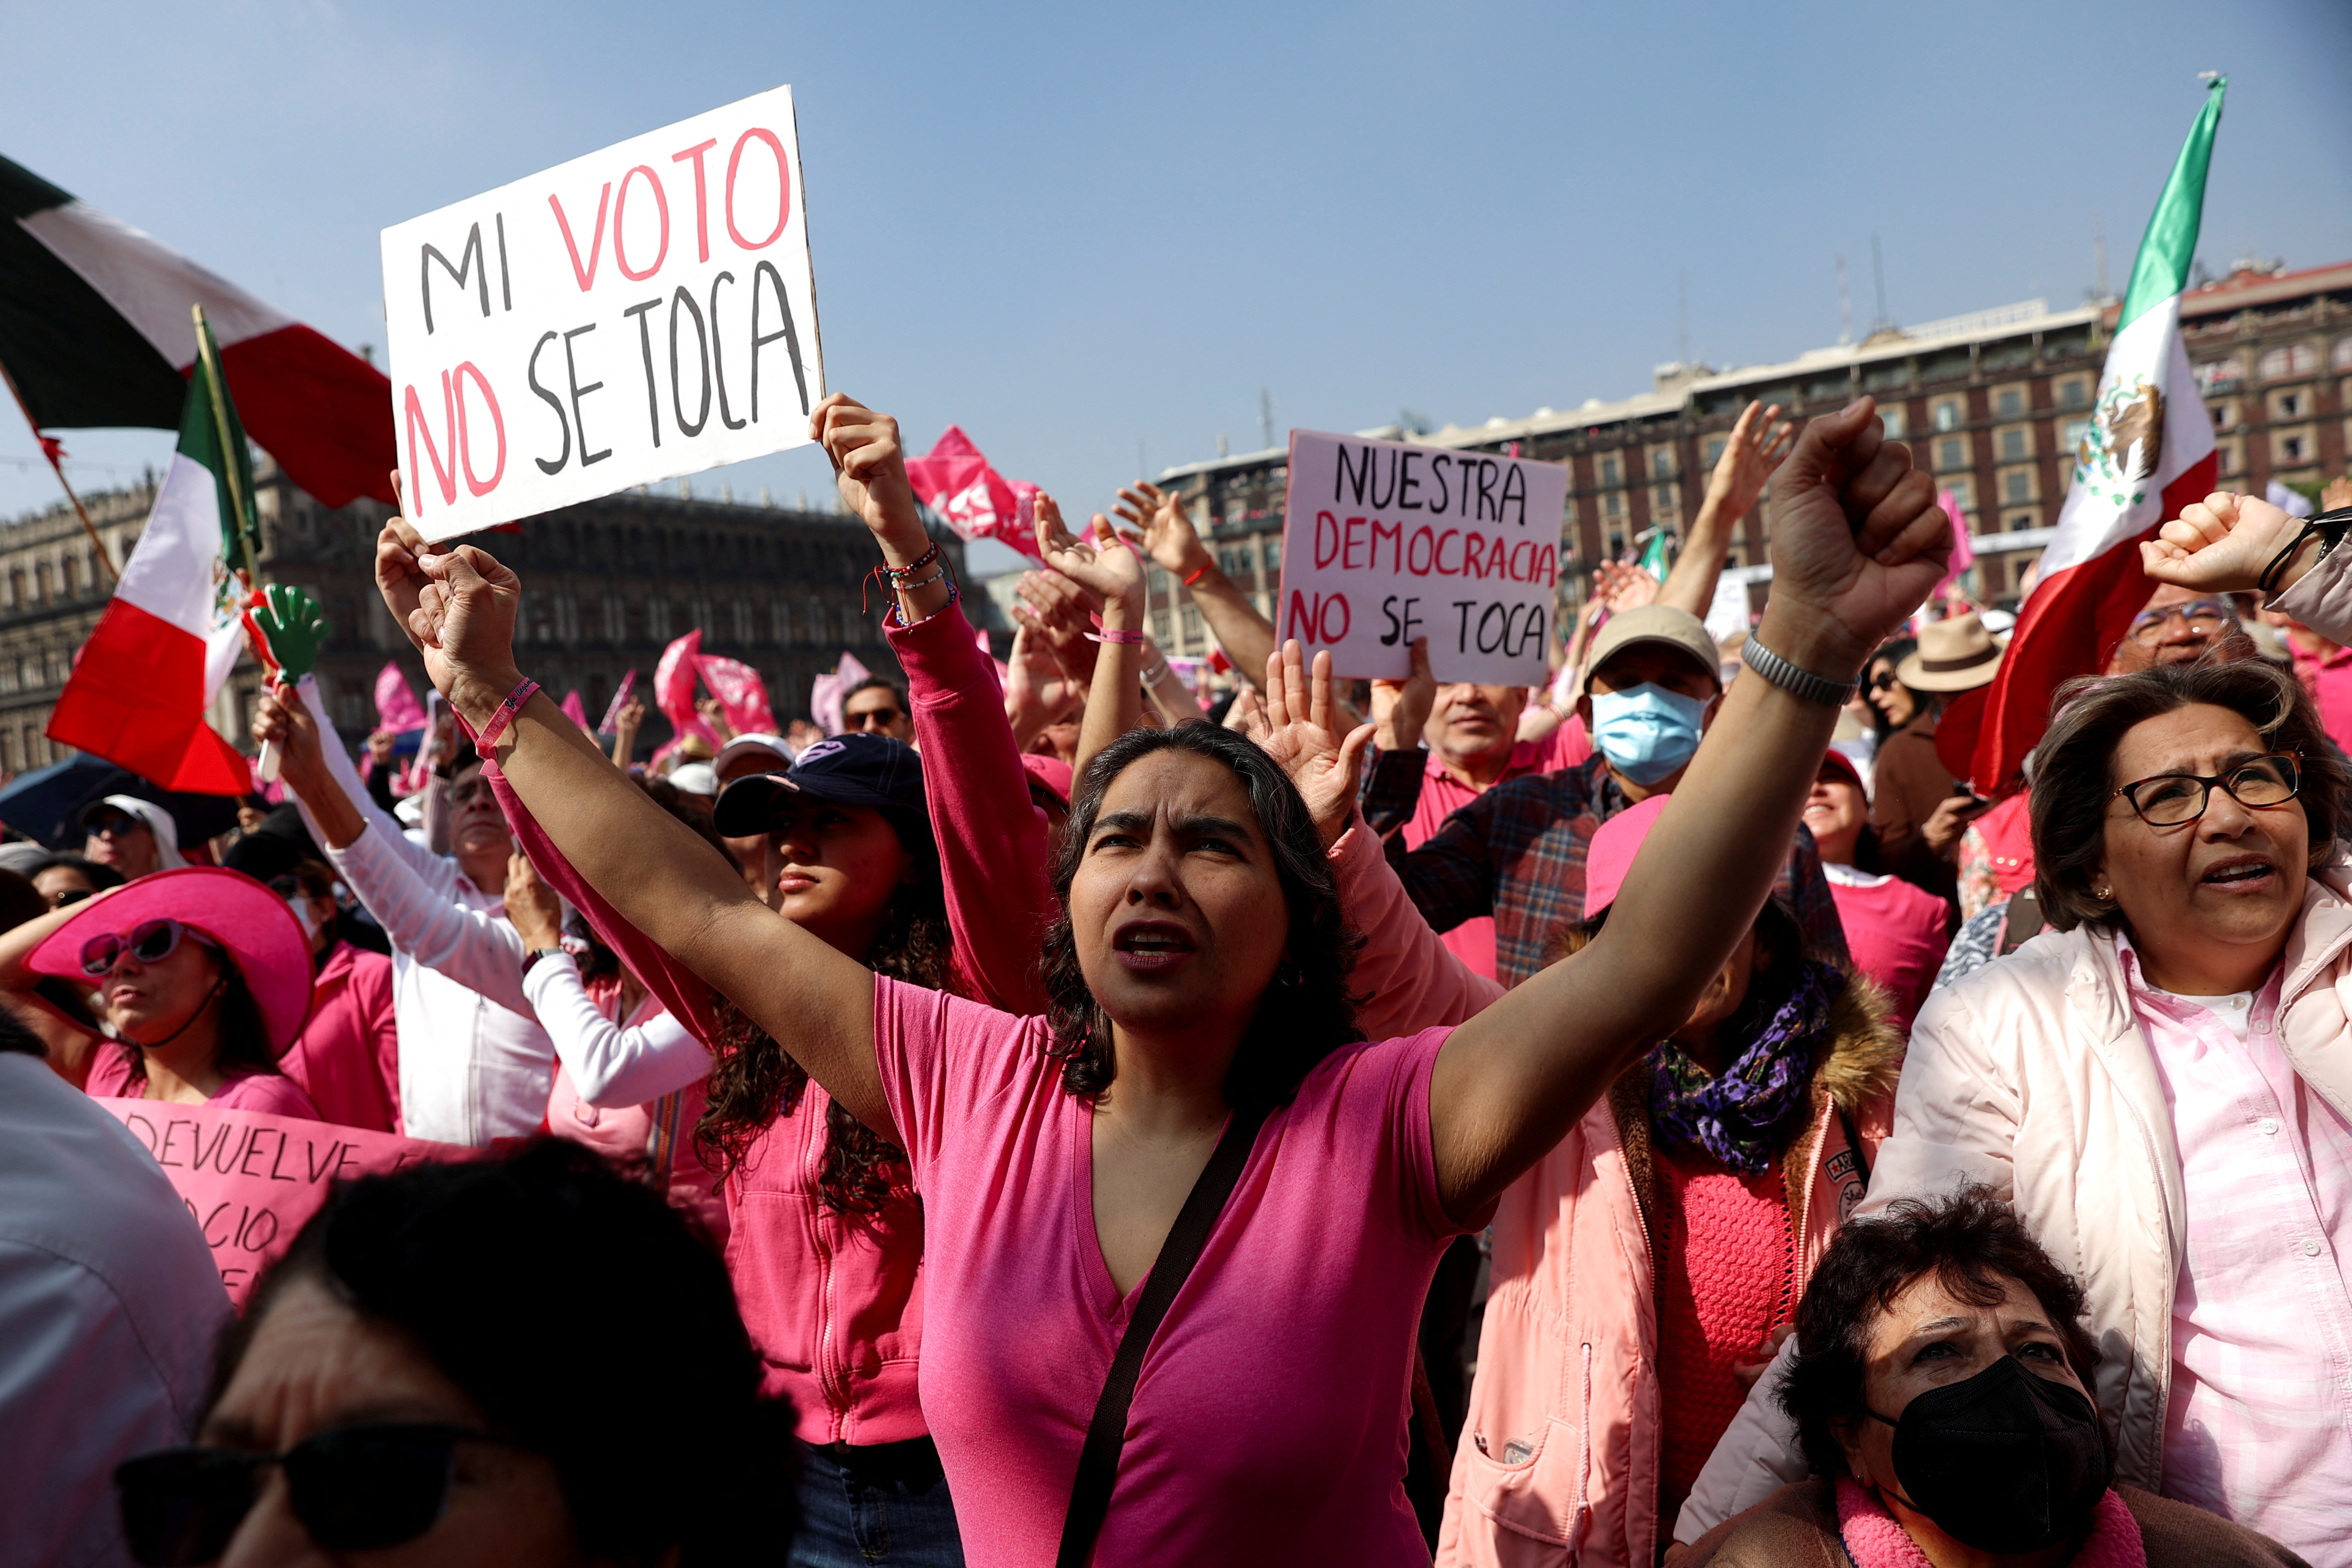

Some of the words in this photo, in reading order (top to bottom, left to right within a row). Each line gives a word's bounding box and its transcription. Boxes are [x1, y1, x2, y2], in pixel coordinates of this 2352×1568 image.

[422, 212, 512, 335] MI
[548, 127, 790, 293] VOTO
[405, 361, 507, 518] NO
[529, 322, 612, 475] SE
[623, 260, 809, 448] TOCA
[1334, 443, 1526, 526] NUESTRA
[1314, 510, 1556, 588] DEMOCRACIA
[1287, 589, 1351, 646] NO
[1380, 596, 1423, 647] SE
[1453, 601, 1545, 661] TOCA
[488, 725, 497, 733] Tu
[505, 697, 517, 709] Ya
